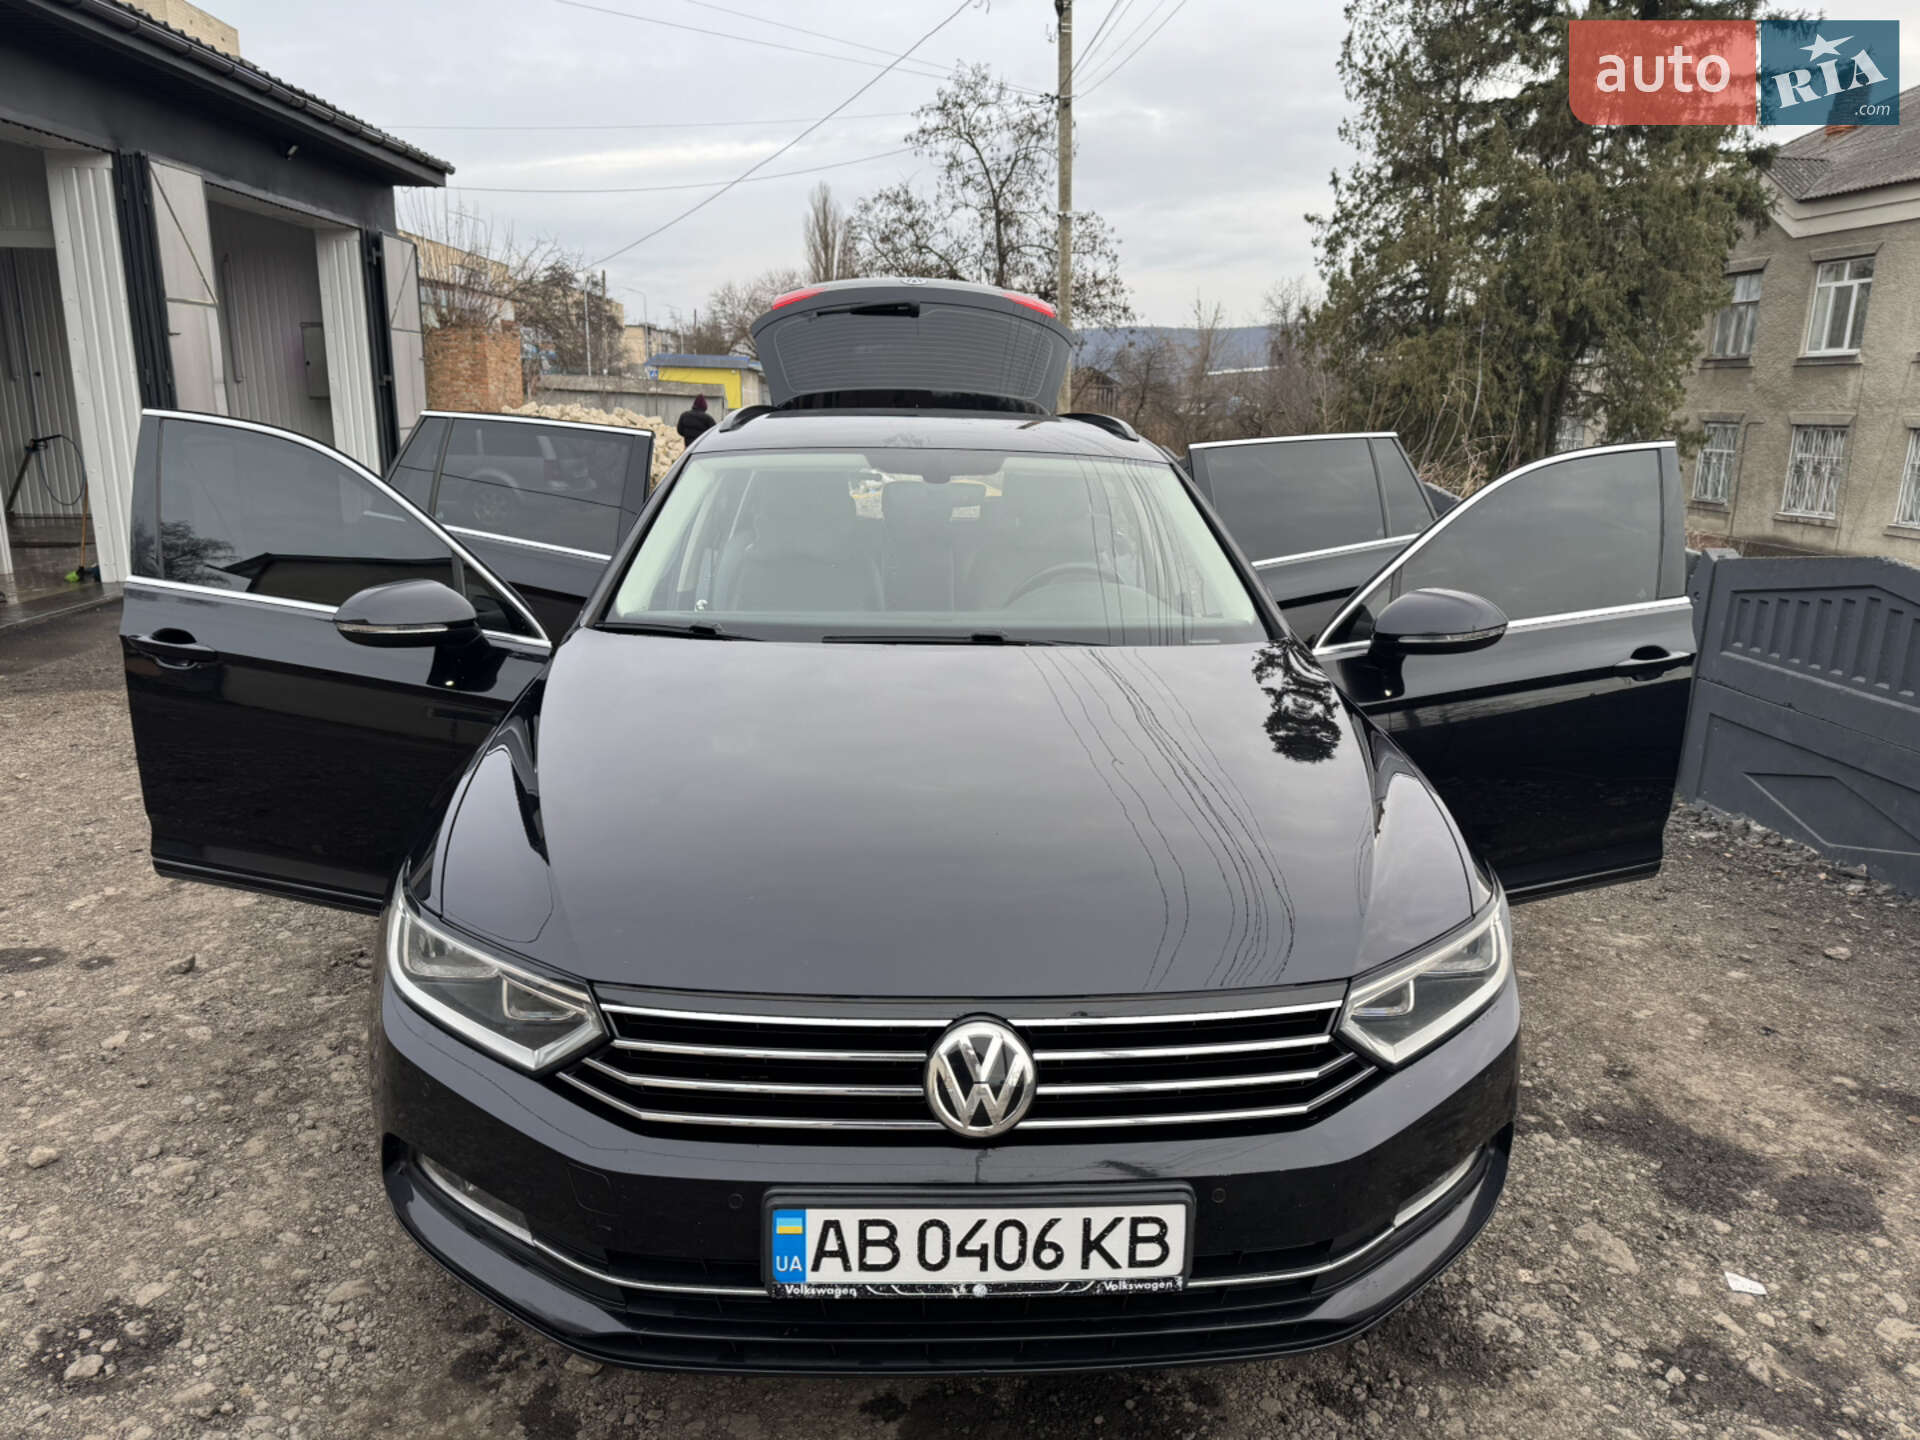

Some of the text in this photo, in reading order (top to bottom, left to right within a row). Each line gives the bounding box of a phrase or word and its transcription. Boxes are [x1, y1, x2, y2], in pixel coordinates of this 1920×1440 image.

[810, 1215, 1171, 1273] AB 0406 KB
[775, 1254, 803, 1273] UA
[784, 1283, 858, 1299] Volkswagen
[1102, 1280, 1174, 1292] Volkswagen
